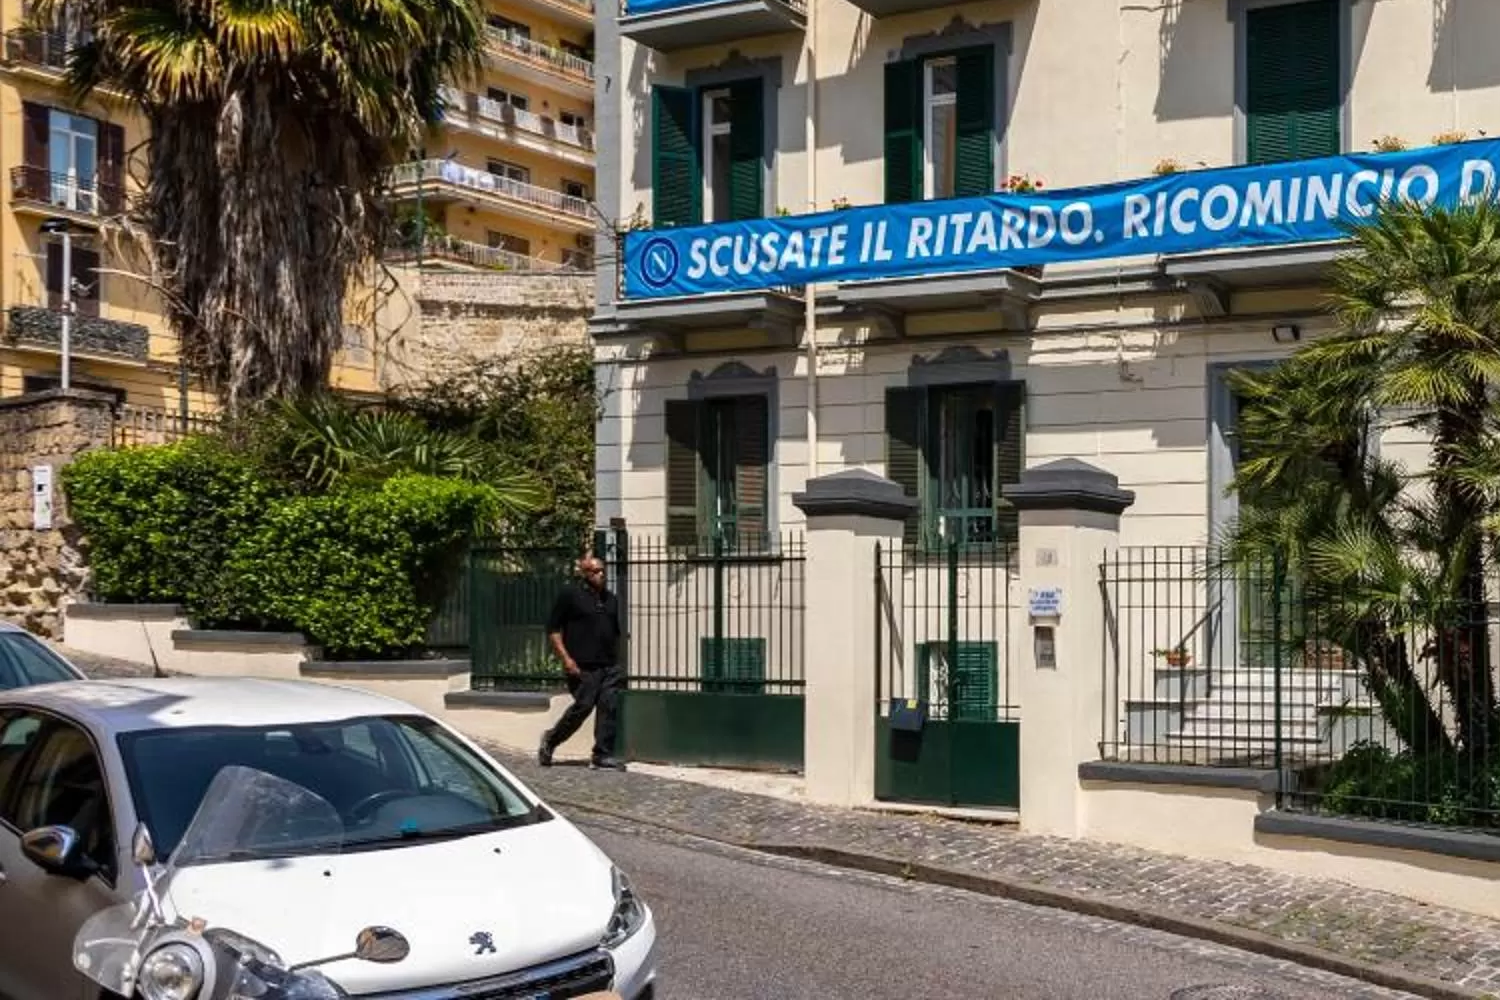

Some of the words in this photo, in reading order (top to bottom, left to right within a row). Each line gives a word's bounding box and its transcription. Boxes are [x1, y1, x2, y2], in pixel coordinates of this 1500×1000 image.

[687, 225, 848, 279] SCUSATE
[860, 220, 892, 263] IL
[908, 203, 1103, 258] RITARDO.
[1124, 165, 1439, 239] RICOMINCIO
[652, 250, 667, 274] N
